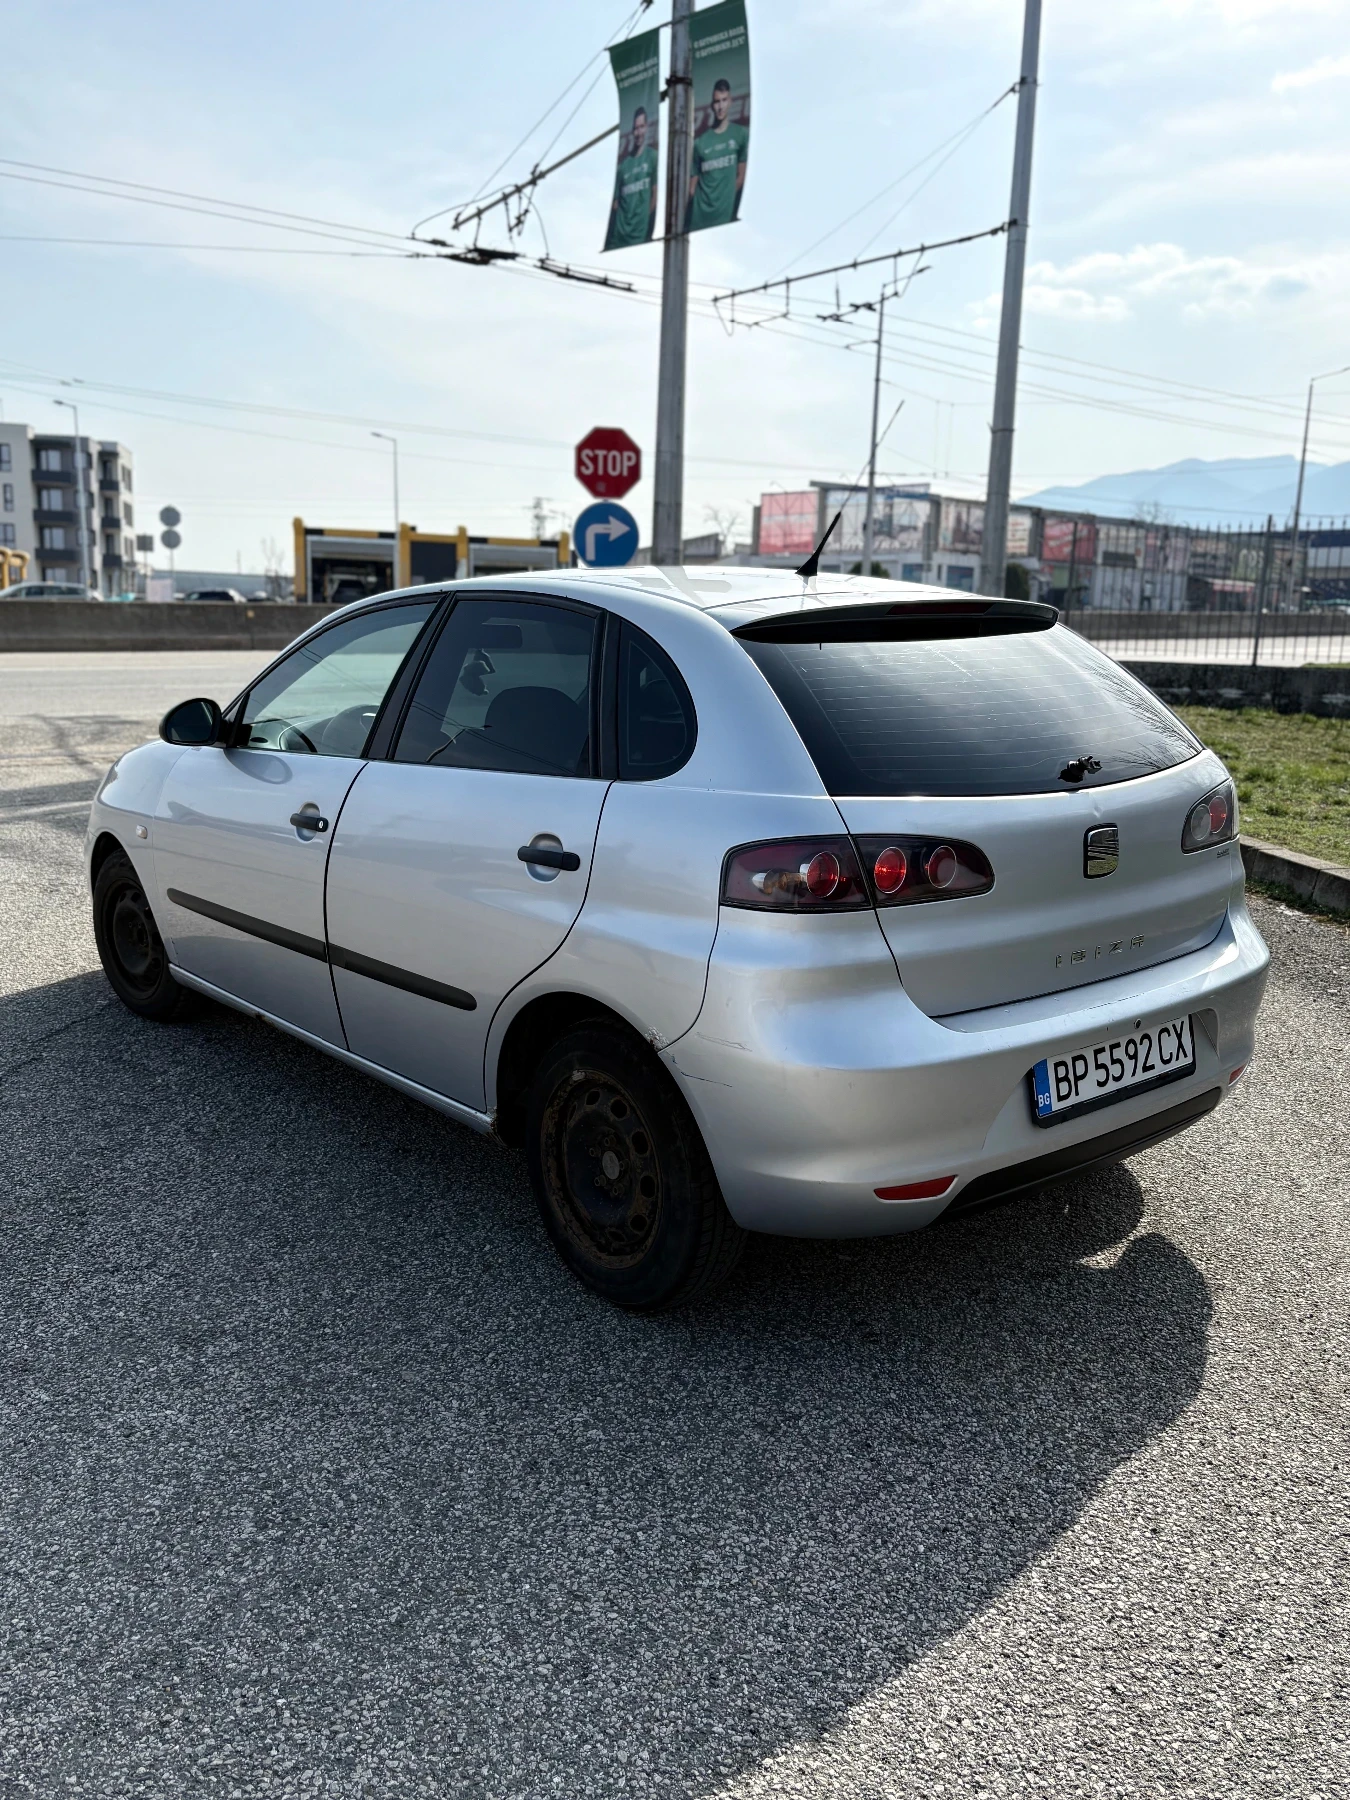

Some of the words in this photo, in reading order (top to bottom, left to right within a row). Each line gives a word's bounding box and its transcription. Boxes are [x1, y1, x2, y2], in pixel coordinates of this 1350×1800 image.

[580, 448, 637, 477] STOP
[1055, 934, 1146, 969] IBIZA
[1053, 1054, 1089, 1103] BP
[1093, 1033, 1154, 1089] 5592
[1157, 1020, 1189, 1064] CX
[1037, 1092, 1051, 1108] BG
